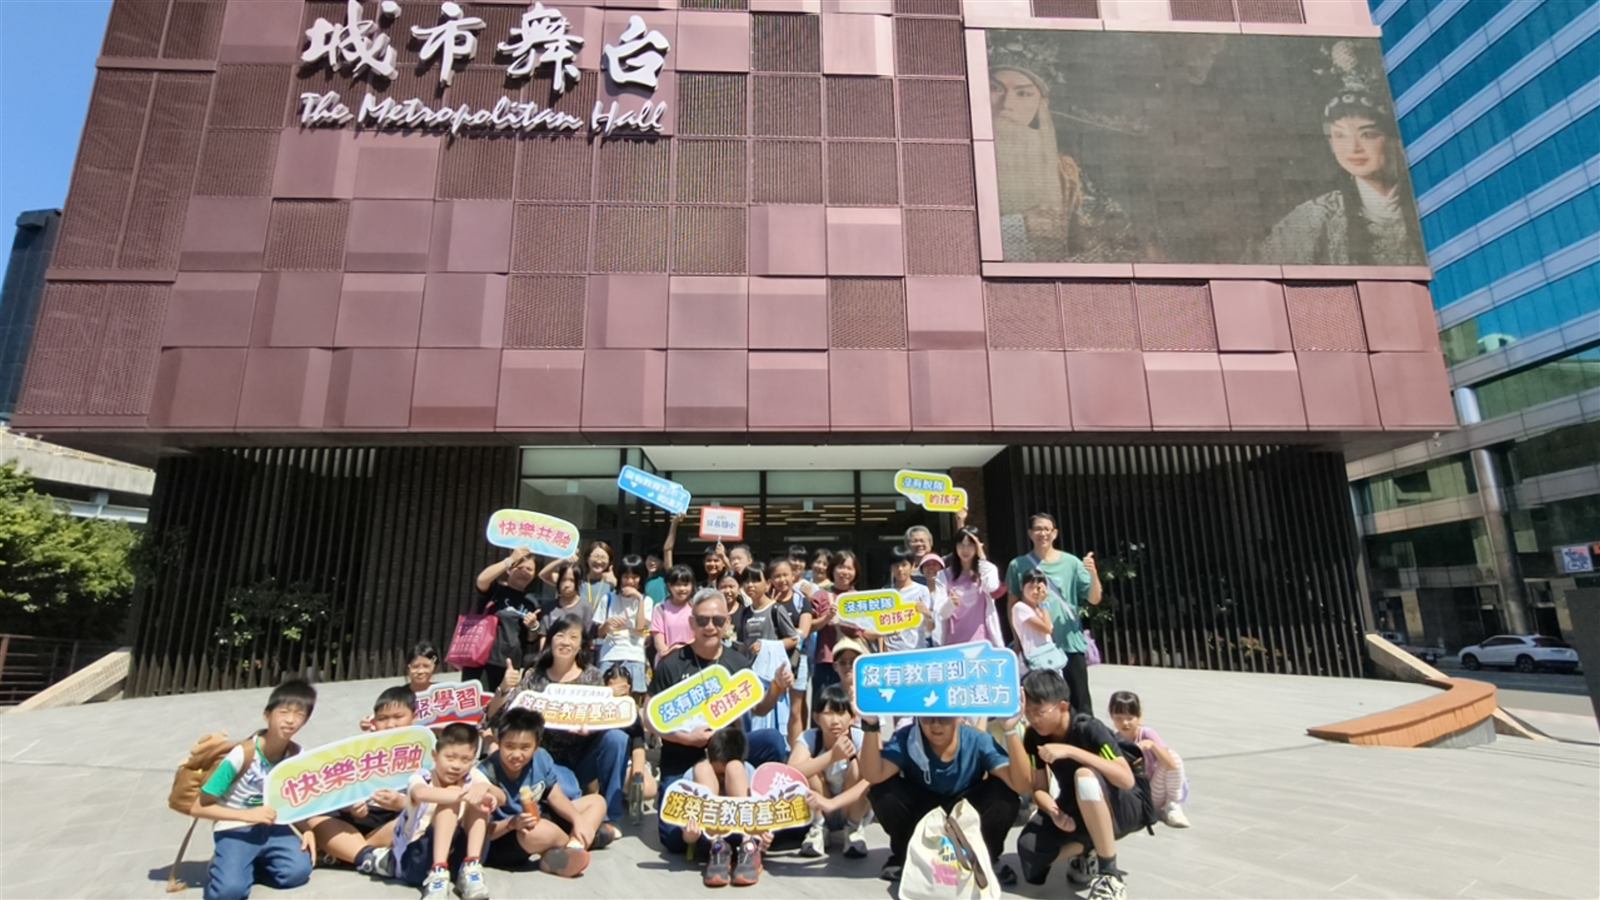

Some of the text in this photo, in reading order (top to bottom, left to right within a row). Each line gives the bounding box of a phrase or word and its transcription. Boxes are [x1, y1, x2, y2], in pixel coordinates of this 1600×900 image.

[302, 0, 670, 94] 城市舞台
[300, 91, 668, 136] The Metropolitan Hall
[498, 520, 572, 549] 快樂共融
[879, 608, 915, 625] 的孩子
[863, 658, 1008, 686] 沒有教育到不了
[711, 680, 752, 718] 的孩子
[947, 685, 1011, 706] 的遠方
[283, 745, 424, 804] 快樂共融
